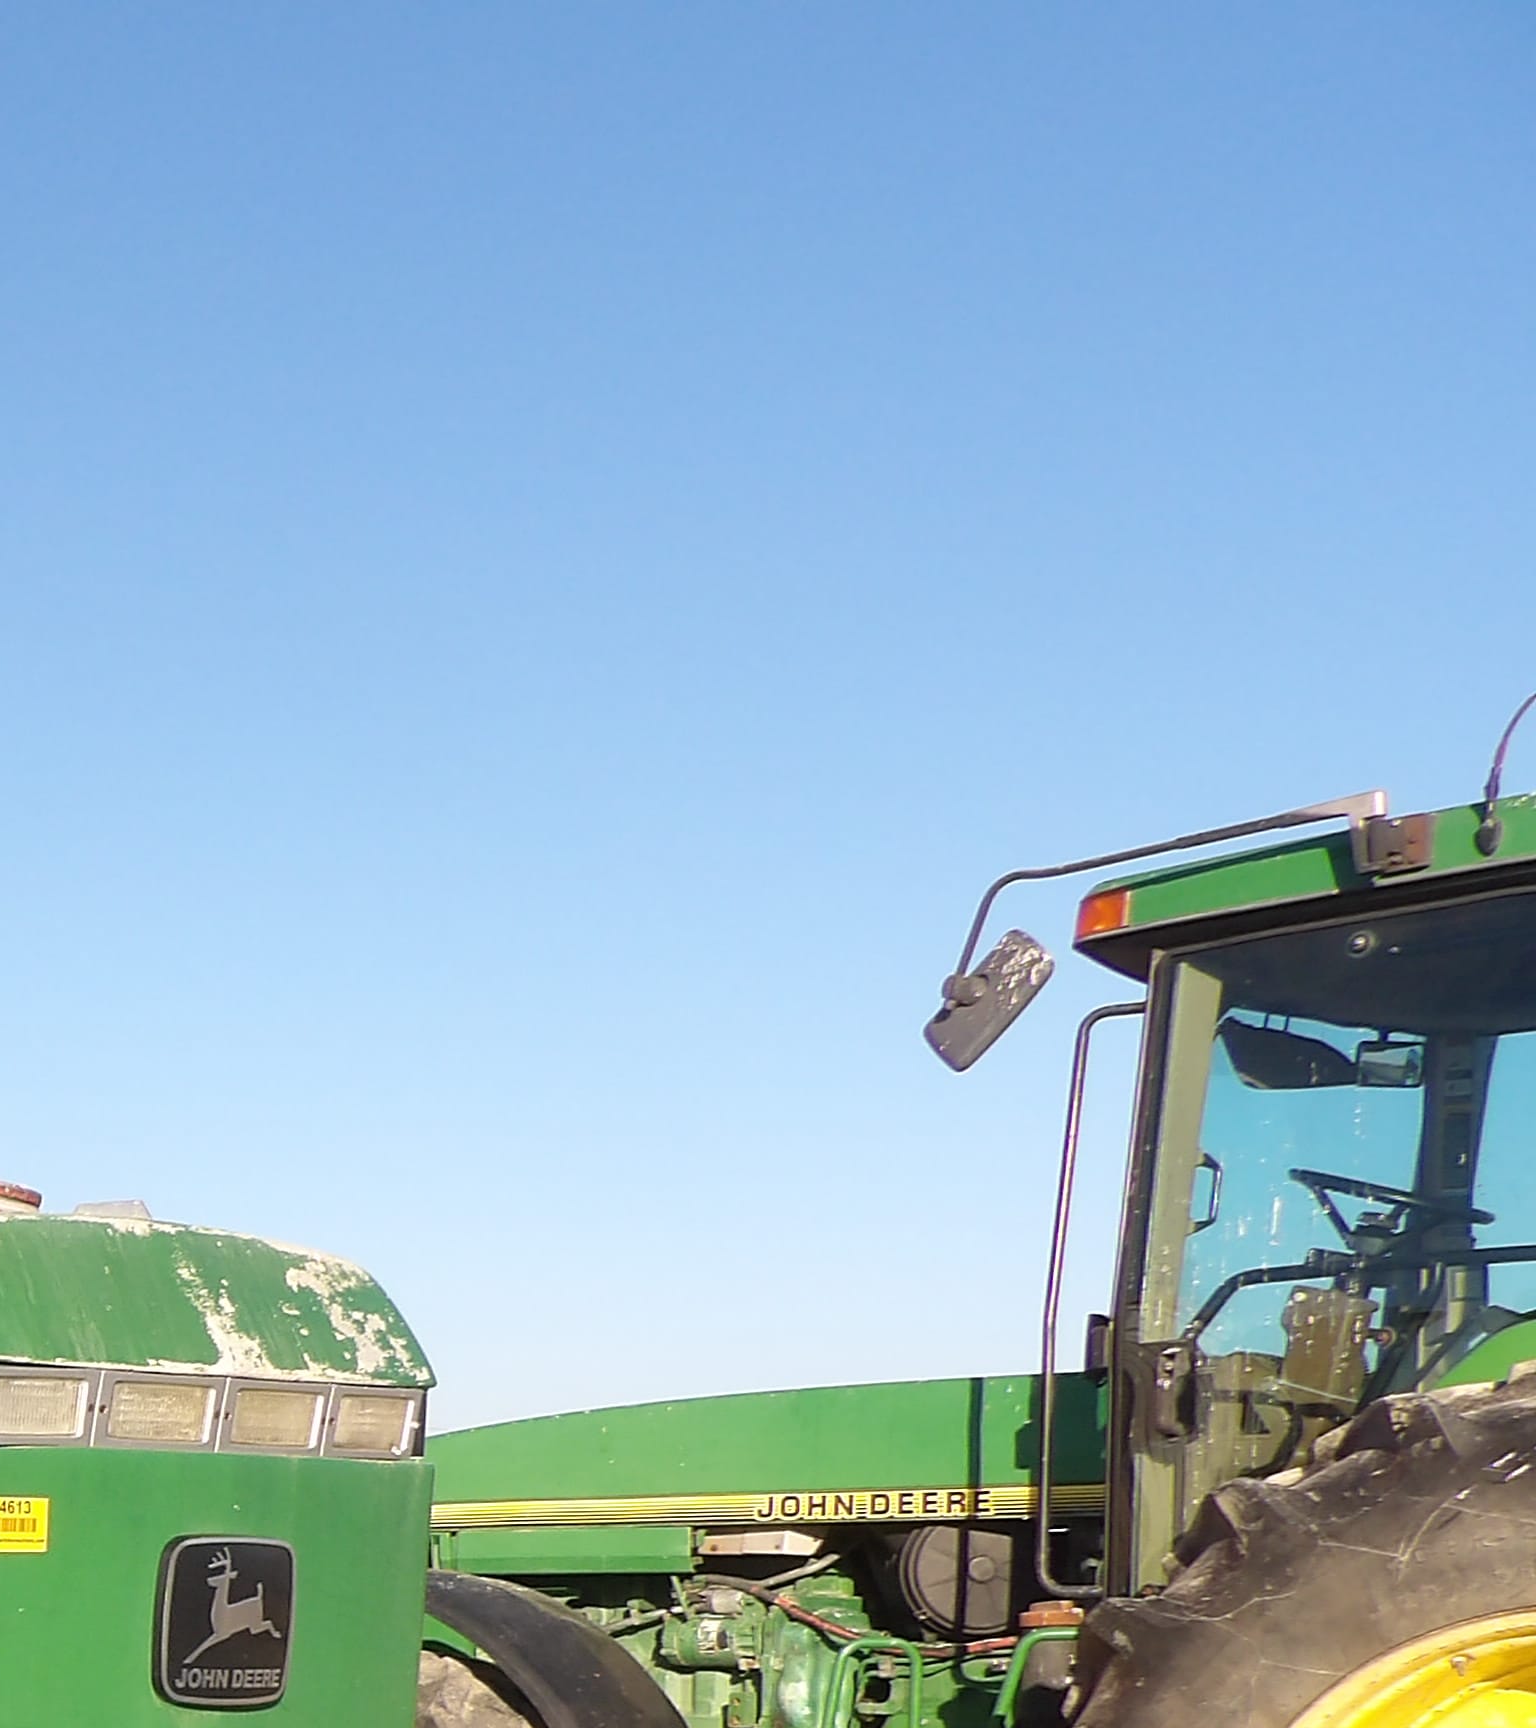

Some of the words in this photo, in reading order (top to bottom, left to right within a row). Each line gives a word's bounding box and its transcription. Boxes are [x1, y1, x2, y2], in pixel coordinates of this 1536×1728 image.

[0, 1500, 31, 1514] 4613
[757, 1495, 854, 1518] JOHN
[870, 1490, 991, 1515] DEERE
[175, 1668, 228, 1688] JOHN
[231, 1668, 281, 1688] DEERE
